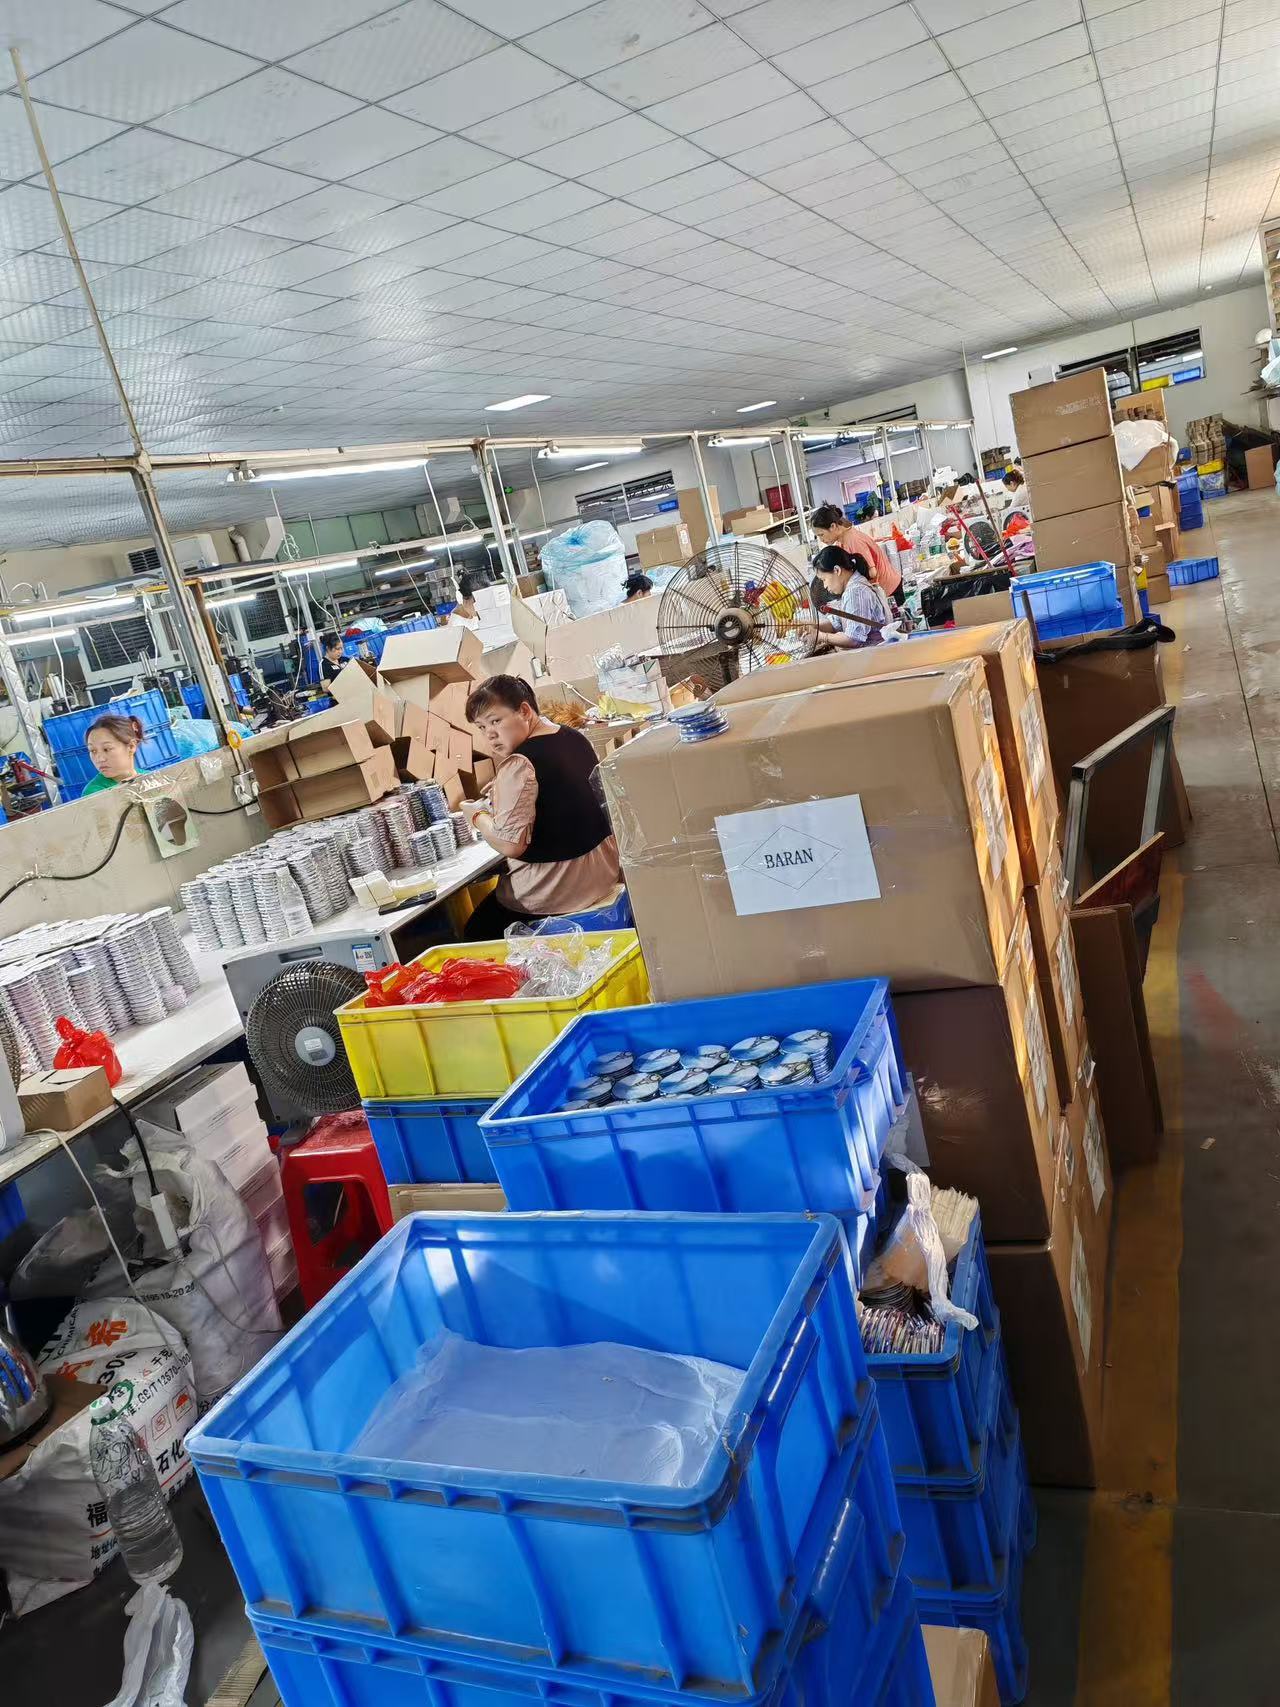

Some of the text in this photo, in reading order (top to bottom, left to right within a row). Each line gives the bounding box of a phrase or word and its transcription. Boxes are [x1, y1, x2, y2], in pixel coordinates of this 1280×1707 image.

[764, 848, 814, 869] BARAN
[151, 1348, 173, 1367] 千克
[87, 1438, 185, 1528] 福 石化
